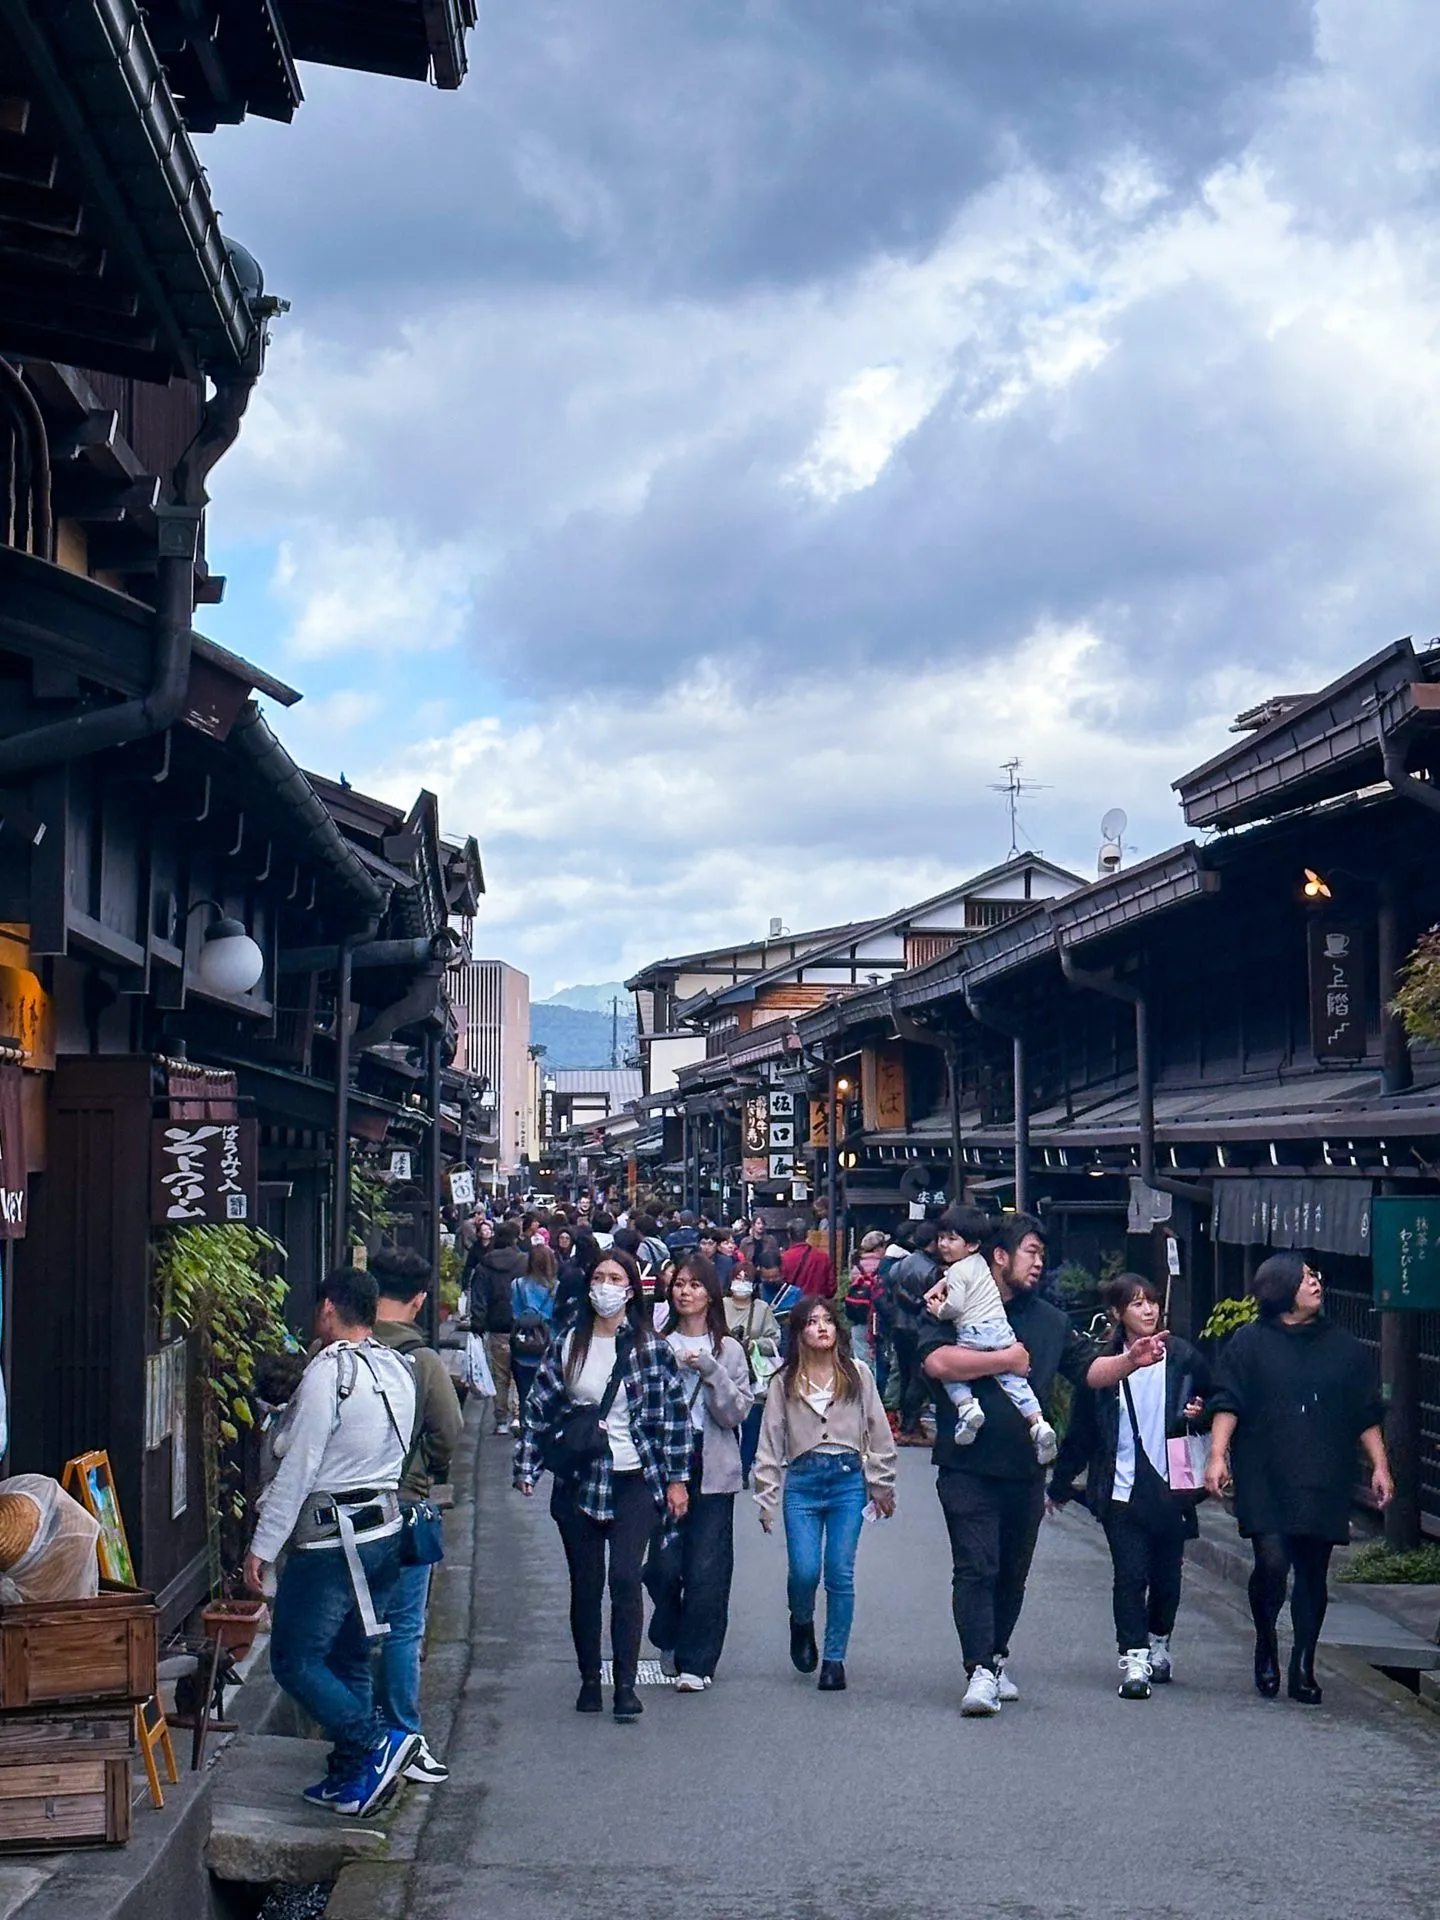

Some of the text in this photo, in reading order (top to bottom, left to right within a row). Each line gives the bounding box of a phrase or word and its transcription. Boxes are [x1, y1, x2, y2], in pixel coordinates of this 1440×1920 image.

[161, 1125, 222, 1219] ソフトクリーム
